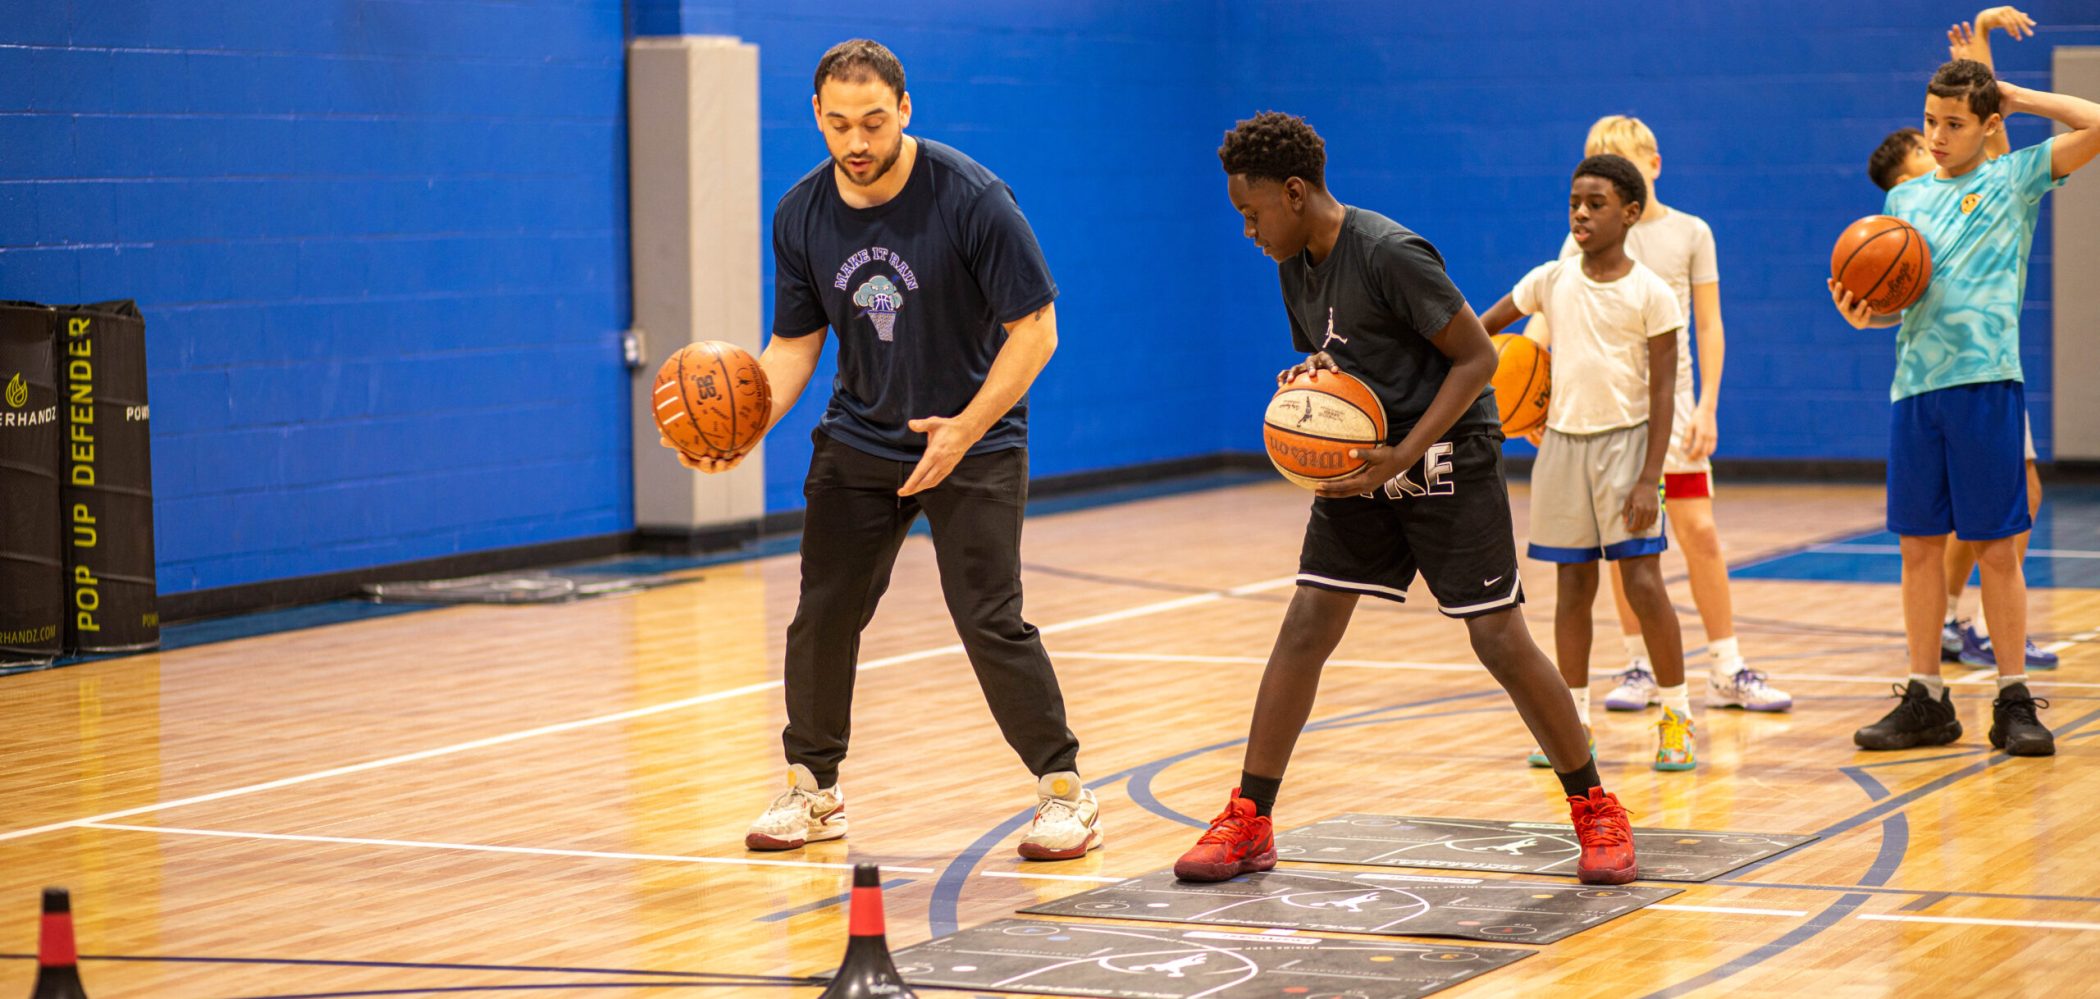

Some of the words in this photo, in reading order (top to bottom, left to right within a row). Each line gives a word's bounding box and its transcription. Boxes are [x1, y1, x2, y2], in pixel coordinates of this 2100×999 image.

[834, 249, 871, 291] MAKE
[872, 247, 888, 261] IT
[889, 252, 919, 291] RAIN
[68, 317, 95, 487] DEFENDER
[1270, 436, 1344, 468] Wilson
[74, 503, 97, 547] UP
[76, 565, 100, 632] POP
